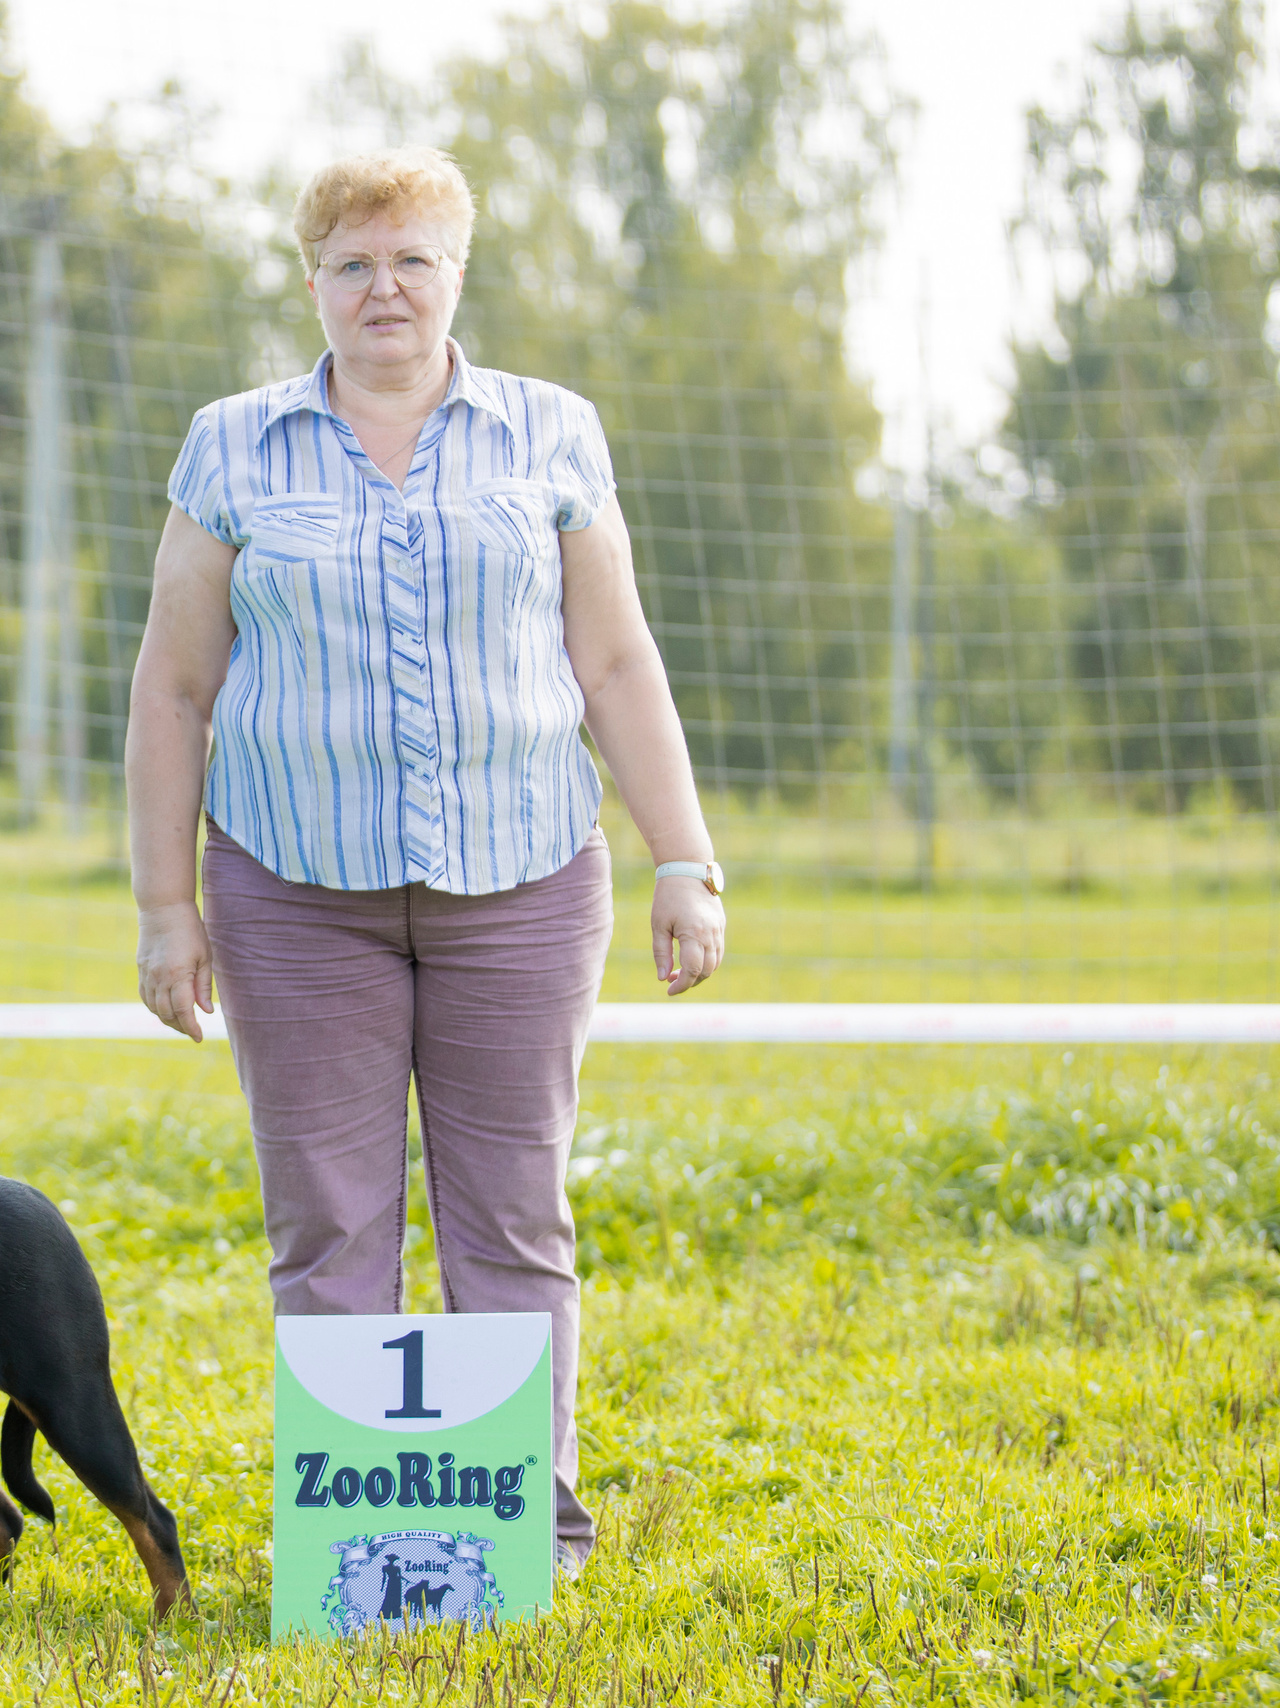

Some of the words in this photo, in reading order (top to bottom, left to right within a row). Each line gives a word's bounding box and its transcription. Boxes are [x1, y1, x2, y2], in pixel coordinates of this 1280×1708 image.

[382, 1330, 442, 1418] 1
[381, 1532, 402, 1540] HIGH
[405, 1531, 442, 1539] QUALITY
